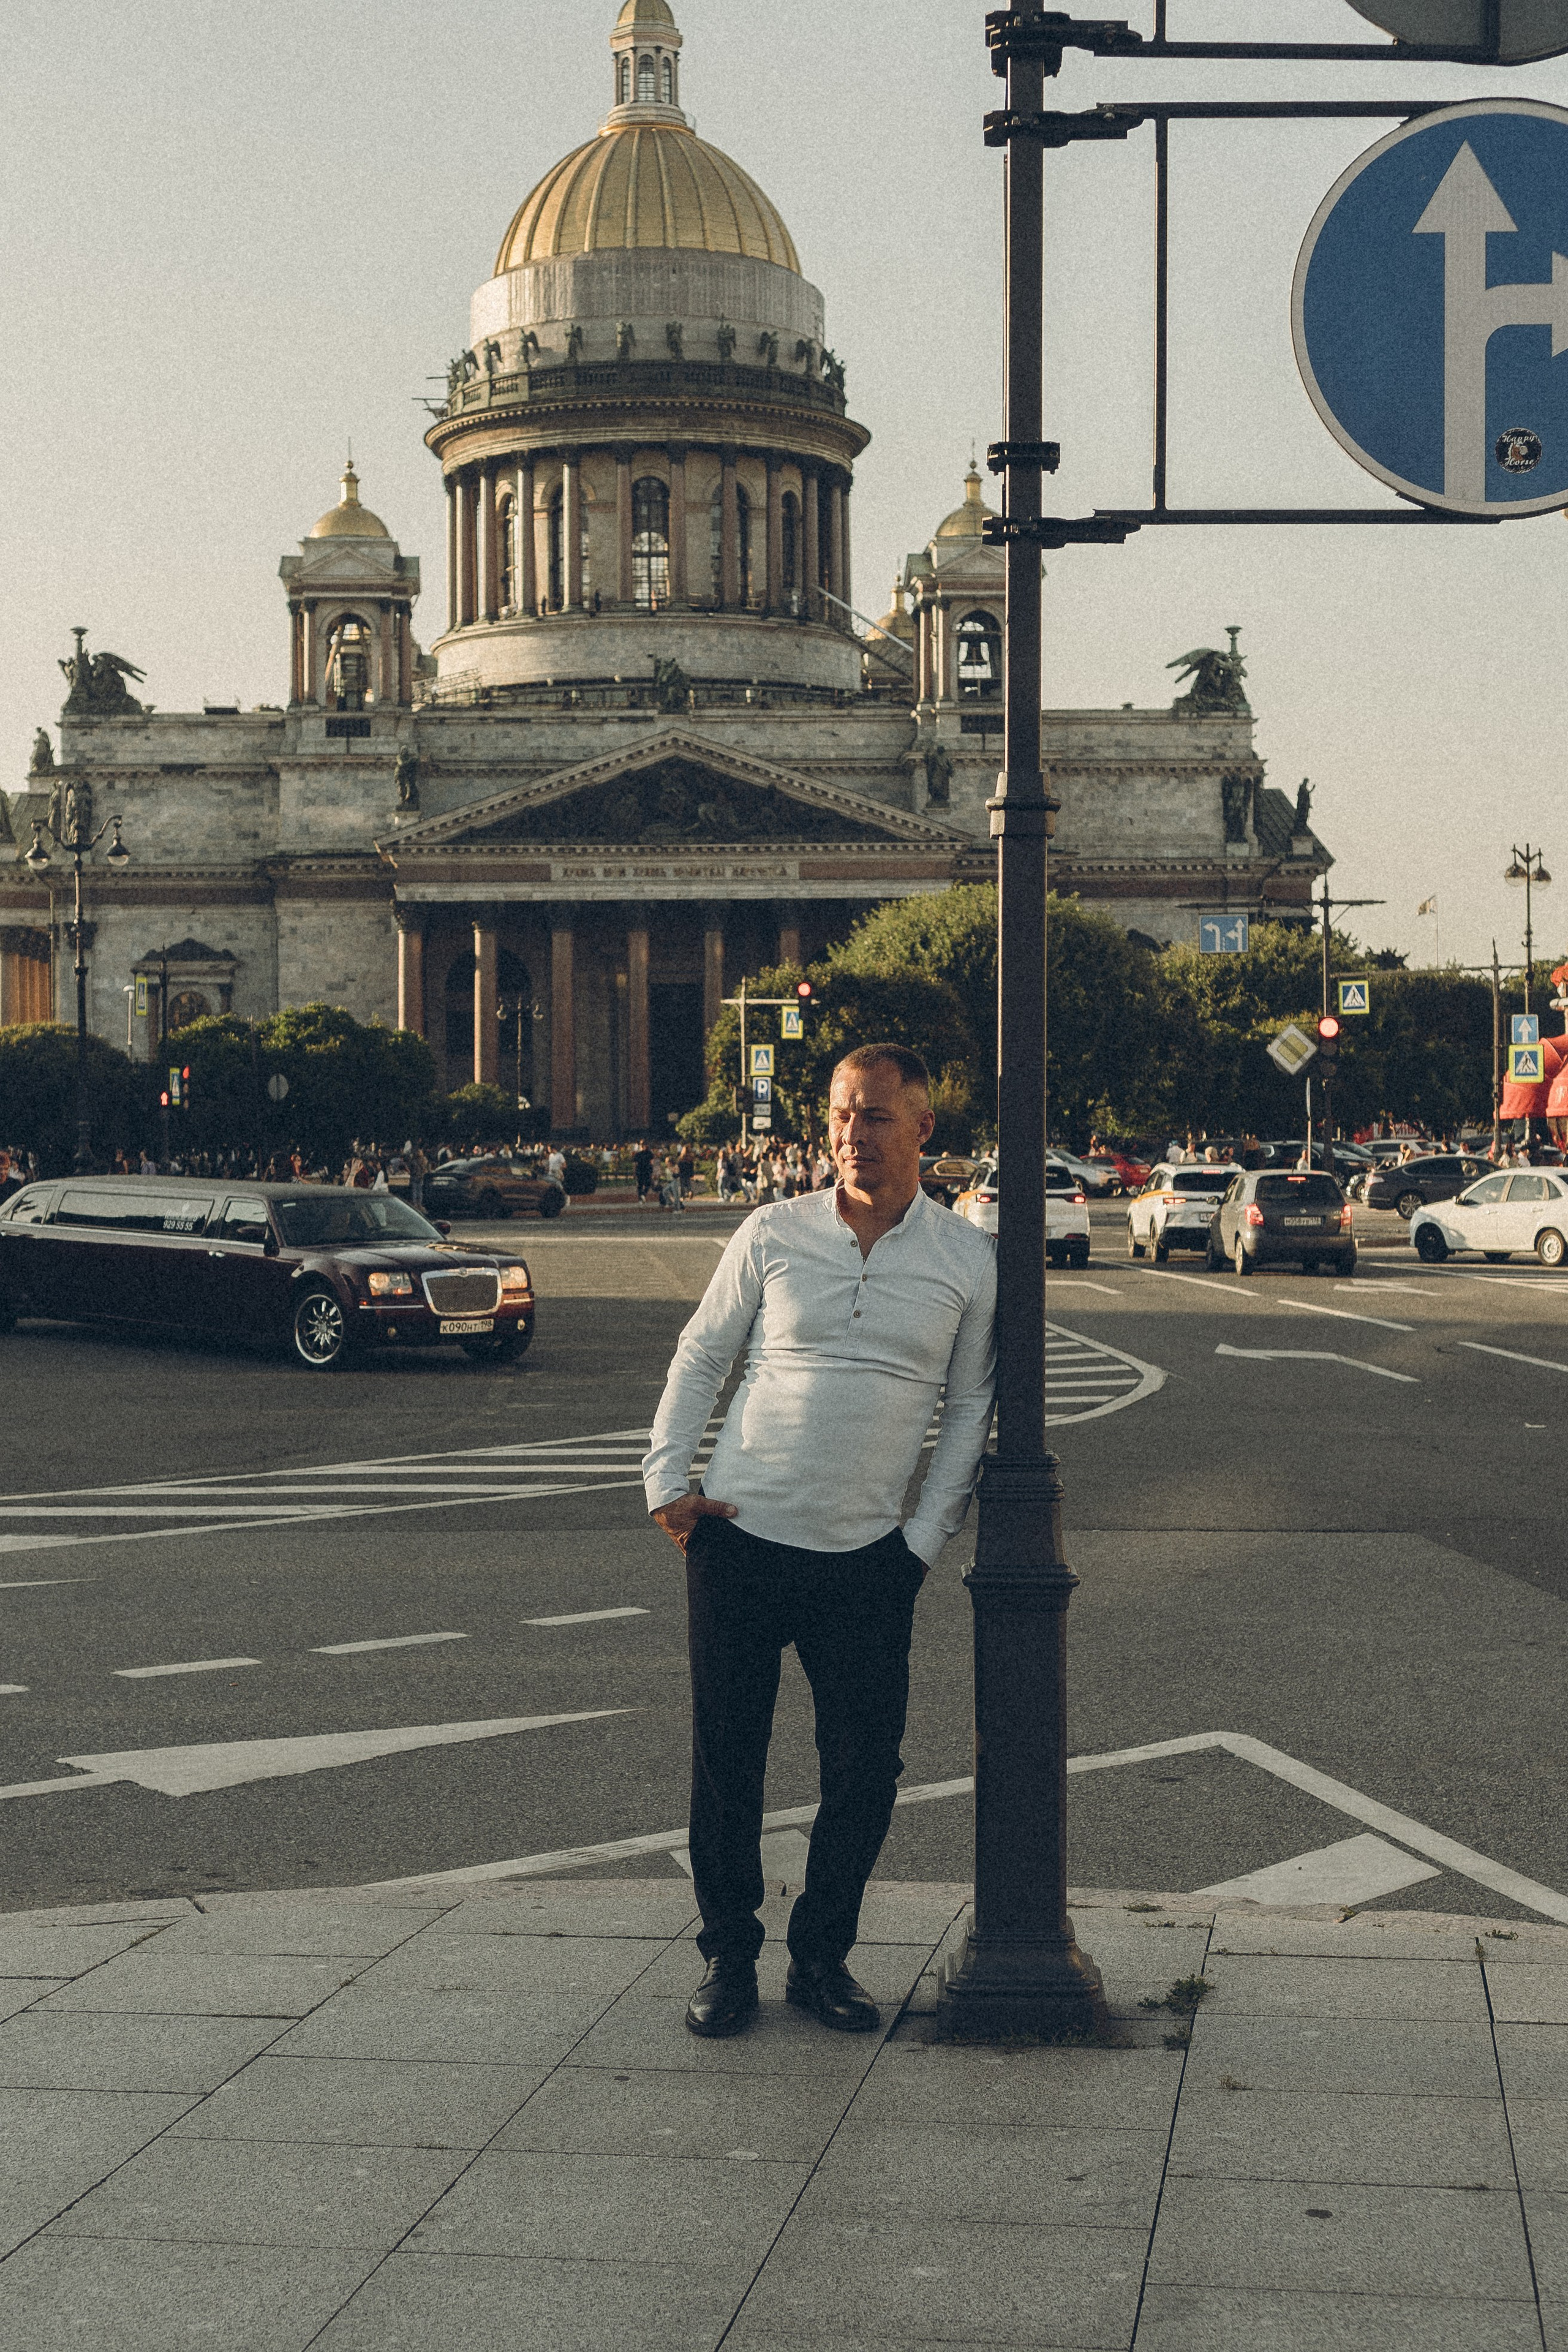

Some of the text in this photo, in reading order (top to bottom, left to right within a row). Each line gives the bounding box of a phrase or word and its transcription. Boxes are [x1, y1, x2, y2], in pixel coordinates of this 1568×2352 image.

[1502, 435, 1536, 444] Happy
[1504, 458, 1534, 466] Horse
[163, 1219, 194, 1231] 929 55 55
